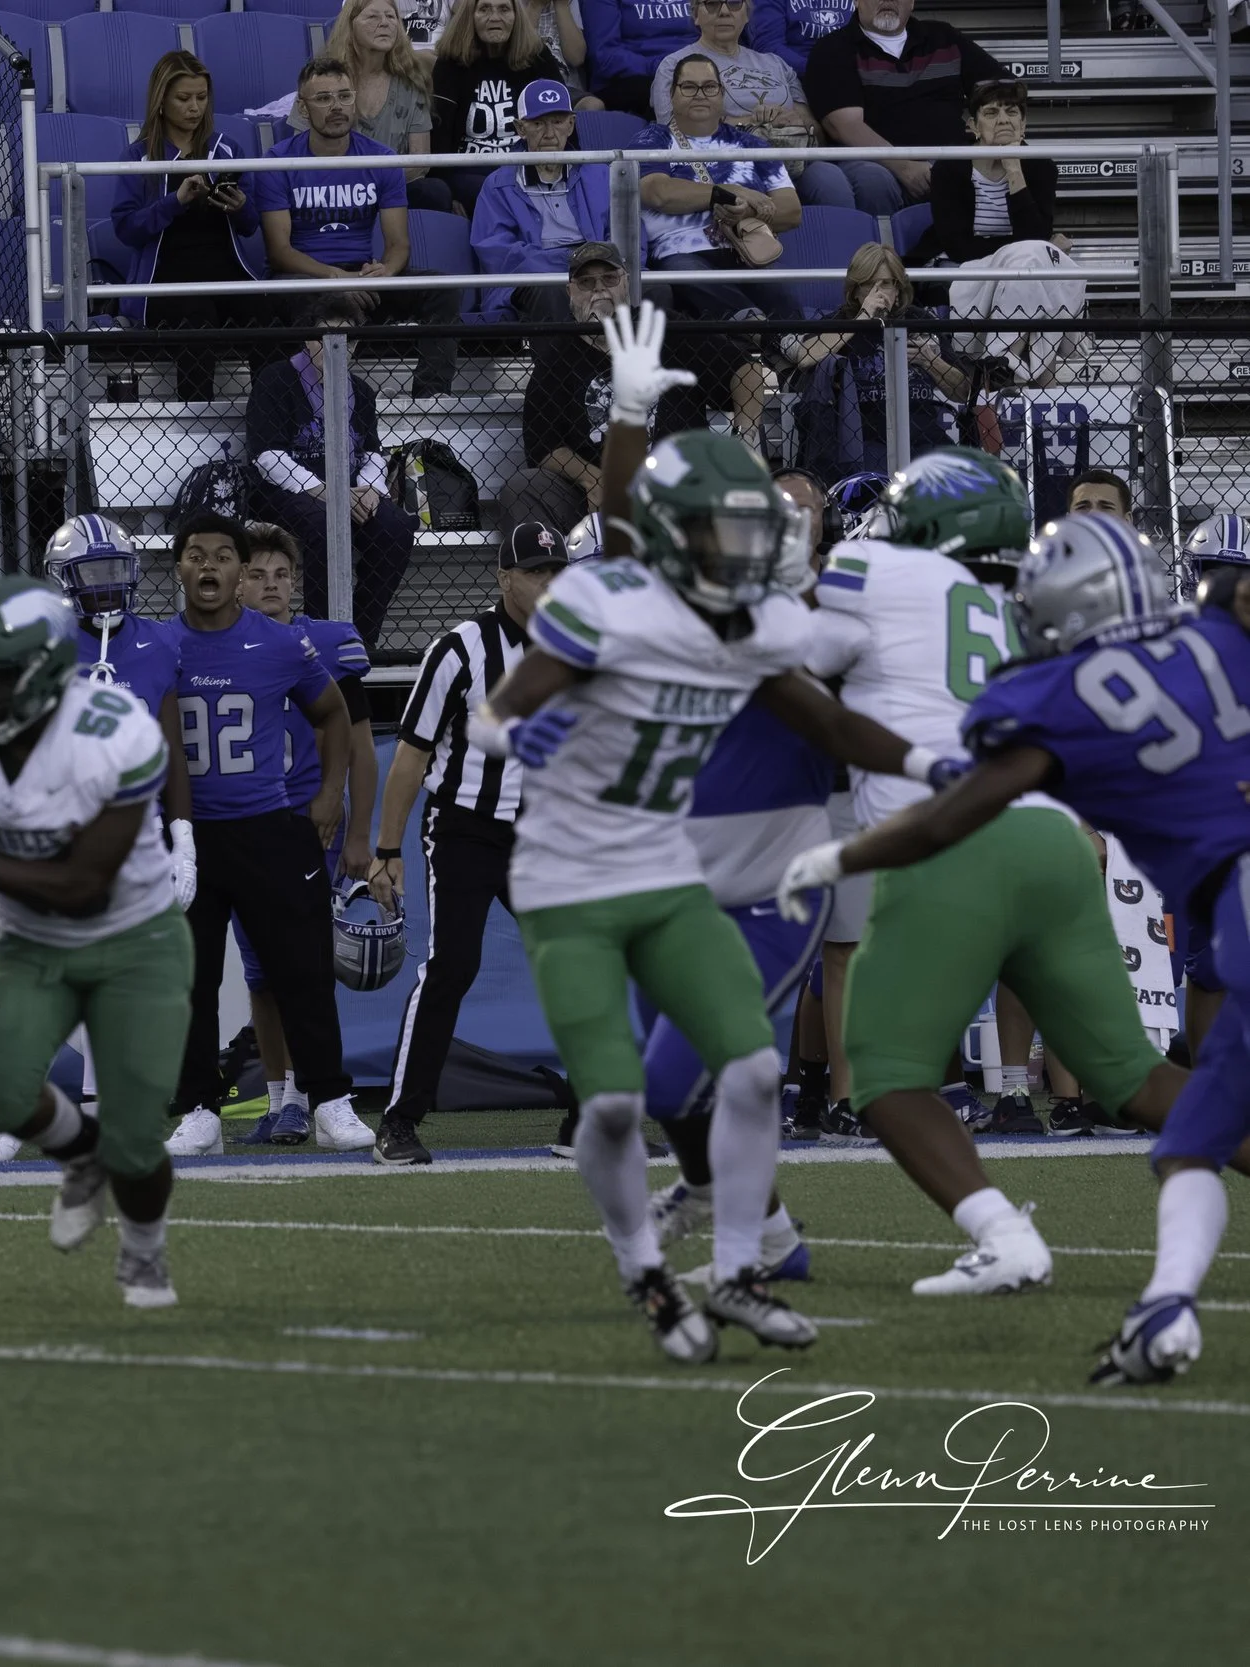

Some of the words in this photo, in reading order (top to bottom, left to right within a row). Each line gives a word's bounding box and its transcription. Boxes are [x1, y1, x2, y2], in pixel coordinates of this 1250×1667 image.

[1100, 161, 1114, 176] C
[1232, 158, 1244, 175] 3
[292, 182, 378, 209] VIKINGS
[1191, 260, 1205, 276] B
[1078, 364, 1102, 382] 47
[190, 675, 232, 688] Vikings
[1073, 625, 1250, 776] 97
[177, 692, 255, 777] 92
[598, 720, 715, 814] 12
[346, 924, 374, 936] WAY
[375, 925, 399, 936] HARD
